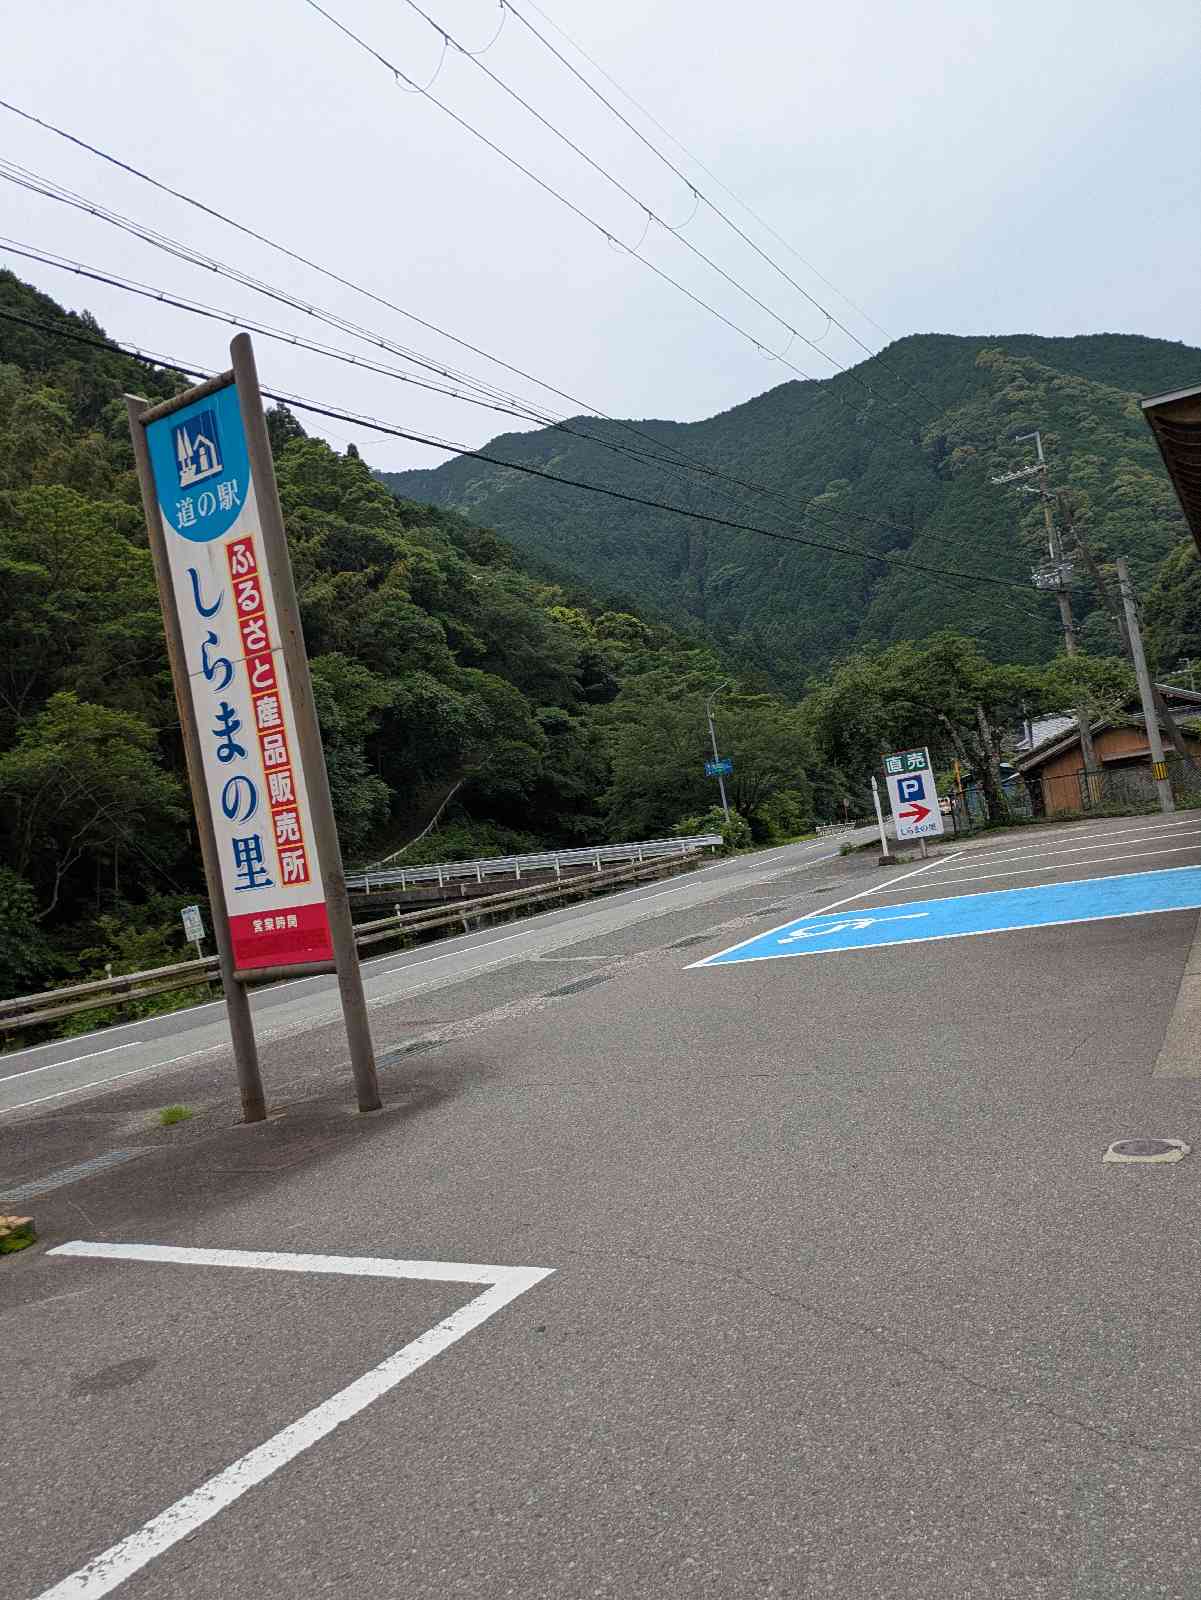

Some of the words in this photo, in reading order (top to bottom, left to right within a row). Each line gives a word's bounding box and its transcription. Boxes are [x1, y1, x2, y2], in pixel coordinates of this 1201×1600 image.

[176, 478, 242, 529] 道の駅
[187, 568, 273, 892] しらまの里
[231, 543, 305, 882] ふるさと産品販売所
[885, 753, 926, 774] 直売
[902, 780, 919, 799] P
[252, 914, 298, 934] 営業時間
